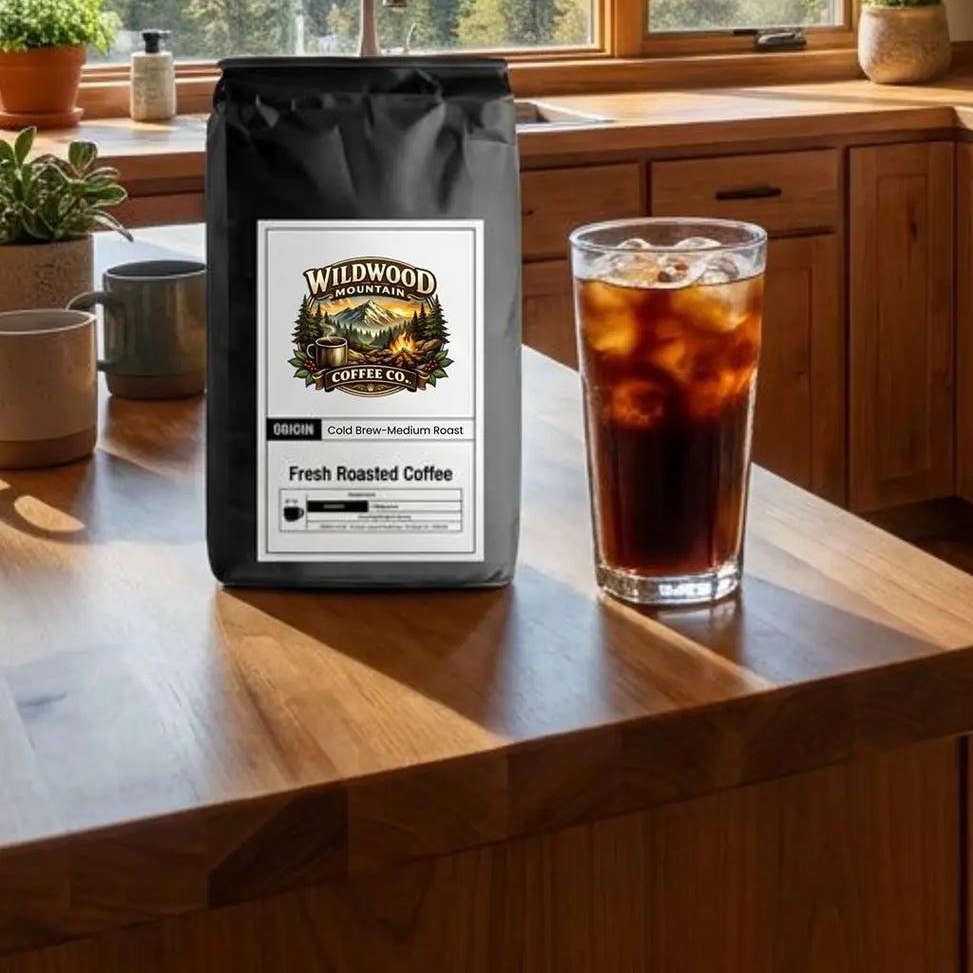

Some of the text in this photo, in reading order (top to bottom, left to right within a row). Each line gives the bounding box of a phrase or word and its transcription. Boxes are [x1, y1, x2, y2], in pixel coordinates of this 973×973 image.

[306, 262, 435, 295] WILDWOOD
[335, 284, 405, 297] MOUNTAIN
[331, 369, 410, 384] COFFEE CO.
[327, 425, 464, 435] Cold Brew-Medium Roast
[289, 465, 453, 481] Fresh Roasted Coffee
